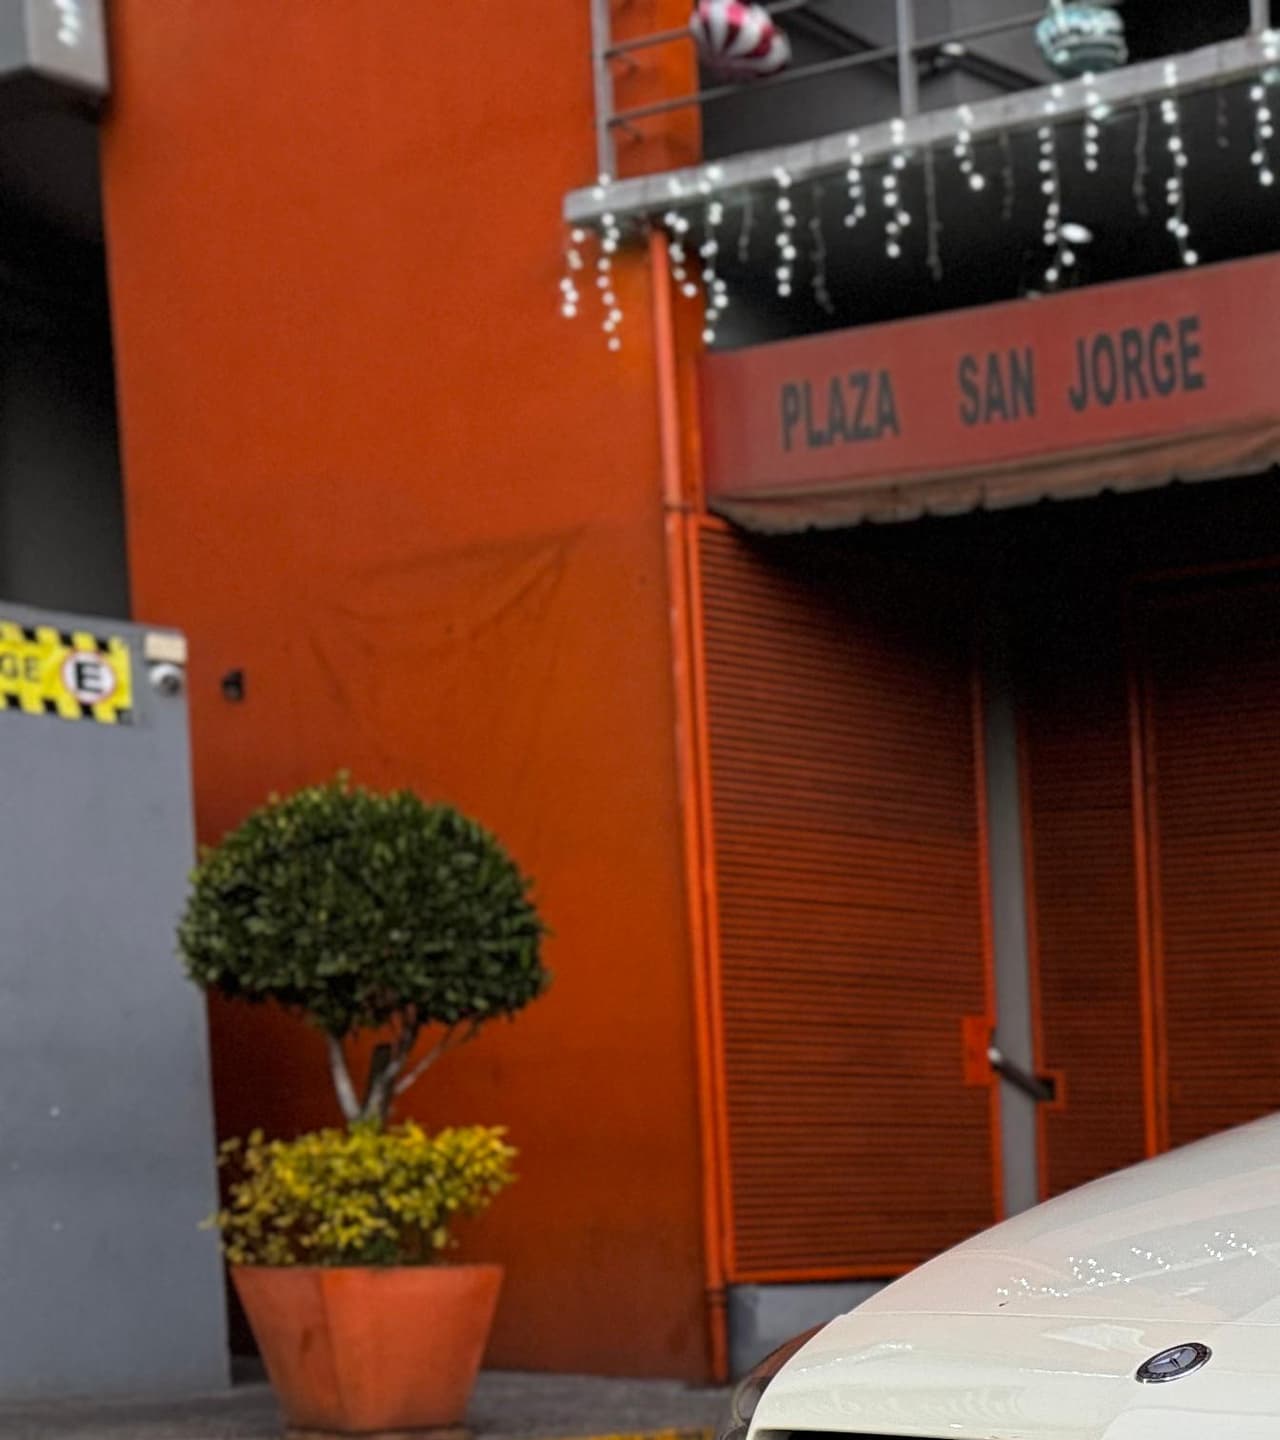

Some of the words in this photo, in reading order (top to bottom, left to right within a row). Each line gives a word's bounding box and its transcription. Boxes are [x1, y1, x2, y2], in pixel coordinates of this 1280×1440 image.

[781, 369, 899, 451] PLAZA
[958, 347, 1034, 425] SAN
[1068, 316, 1206, 410] JORGE
